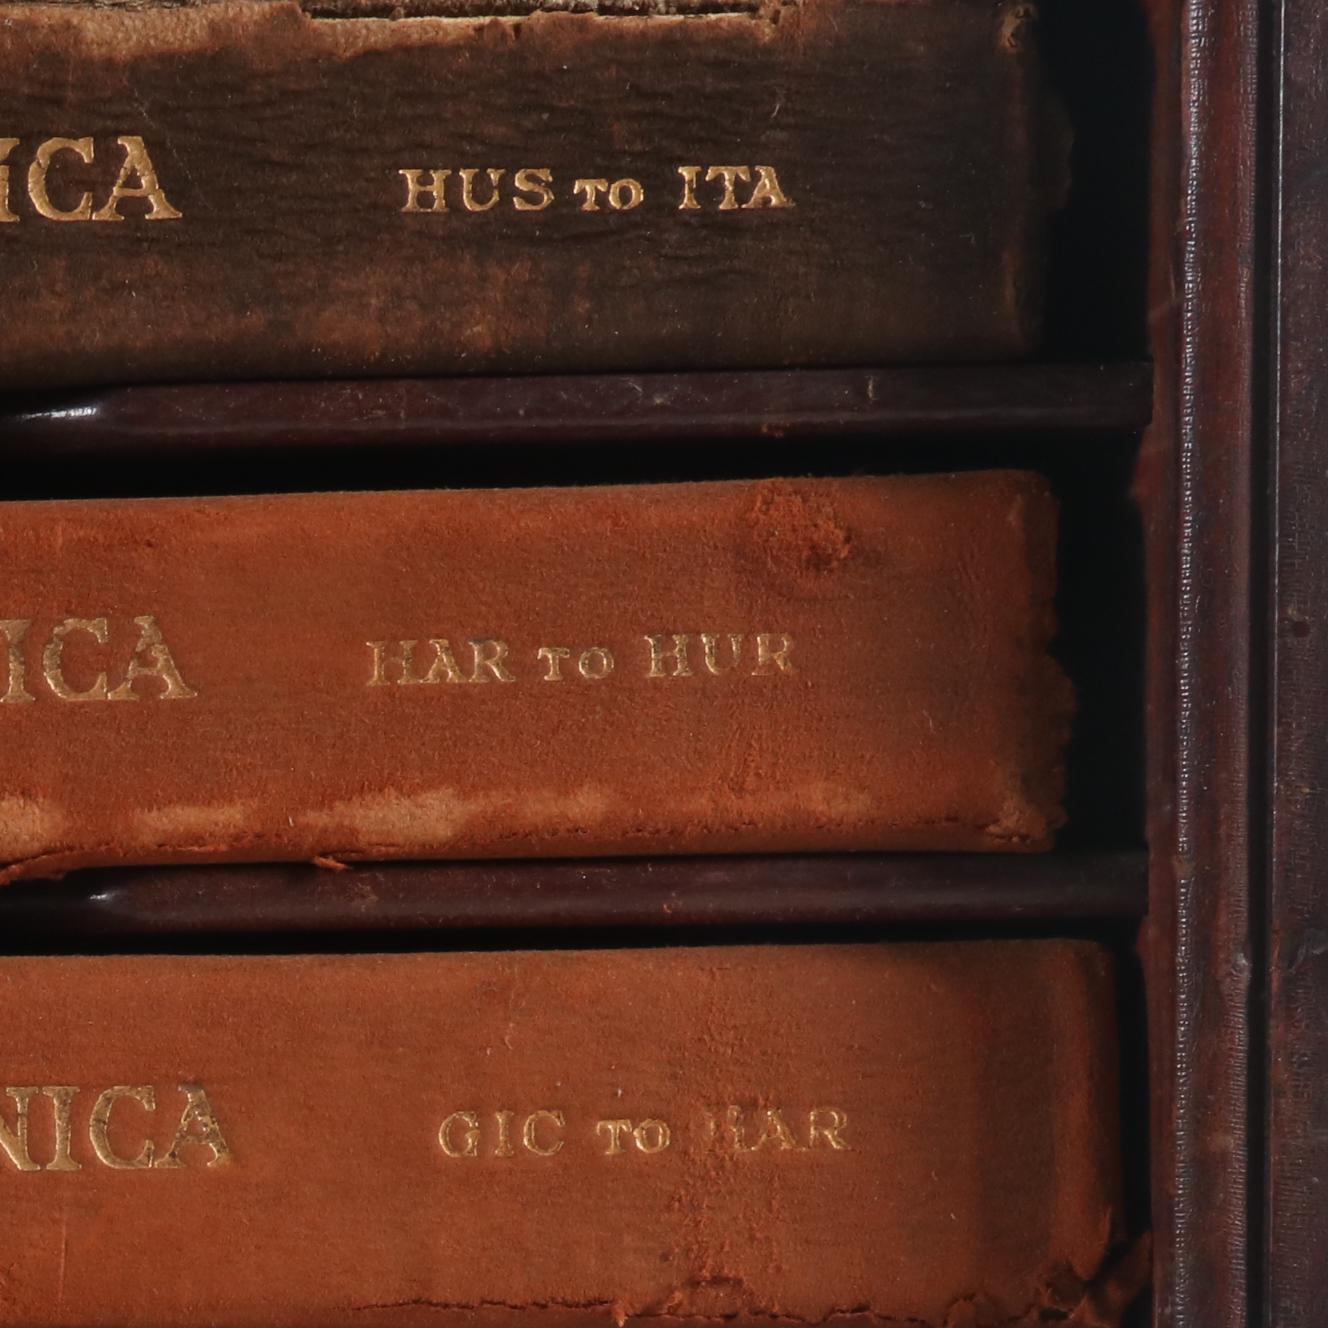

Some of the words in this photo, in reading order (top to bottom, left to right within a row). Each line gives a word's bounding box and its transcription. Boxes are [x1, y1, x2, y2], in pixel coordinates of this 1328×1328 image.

[399, 168, 555, 213] HUS
[677, 165, 794, 210] ITA
[365, 638, 516, 687] HAR
[644, 632, 796, 679] HUR
[438, 1110, 566, 1158] GIC
